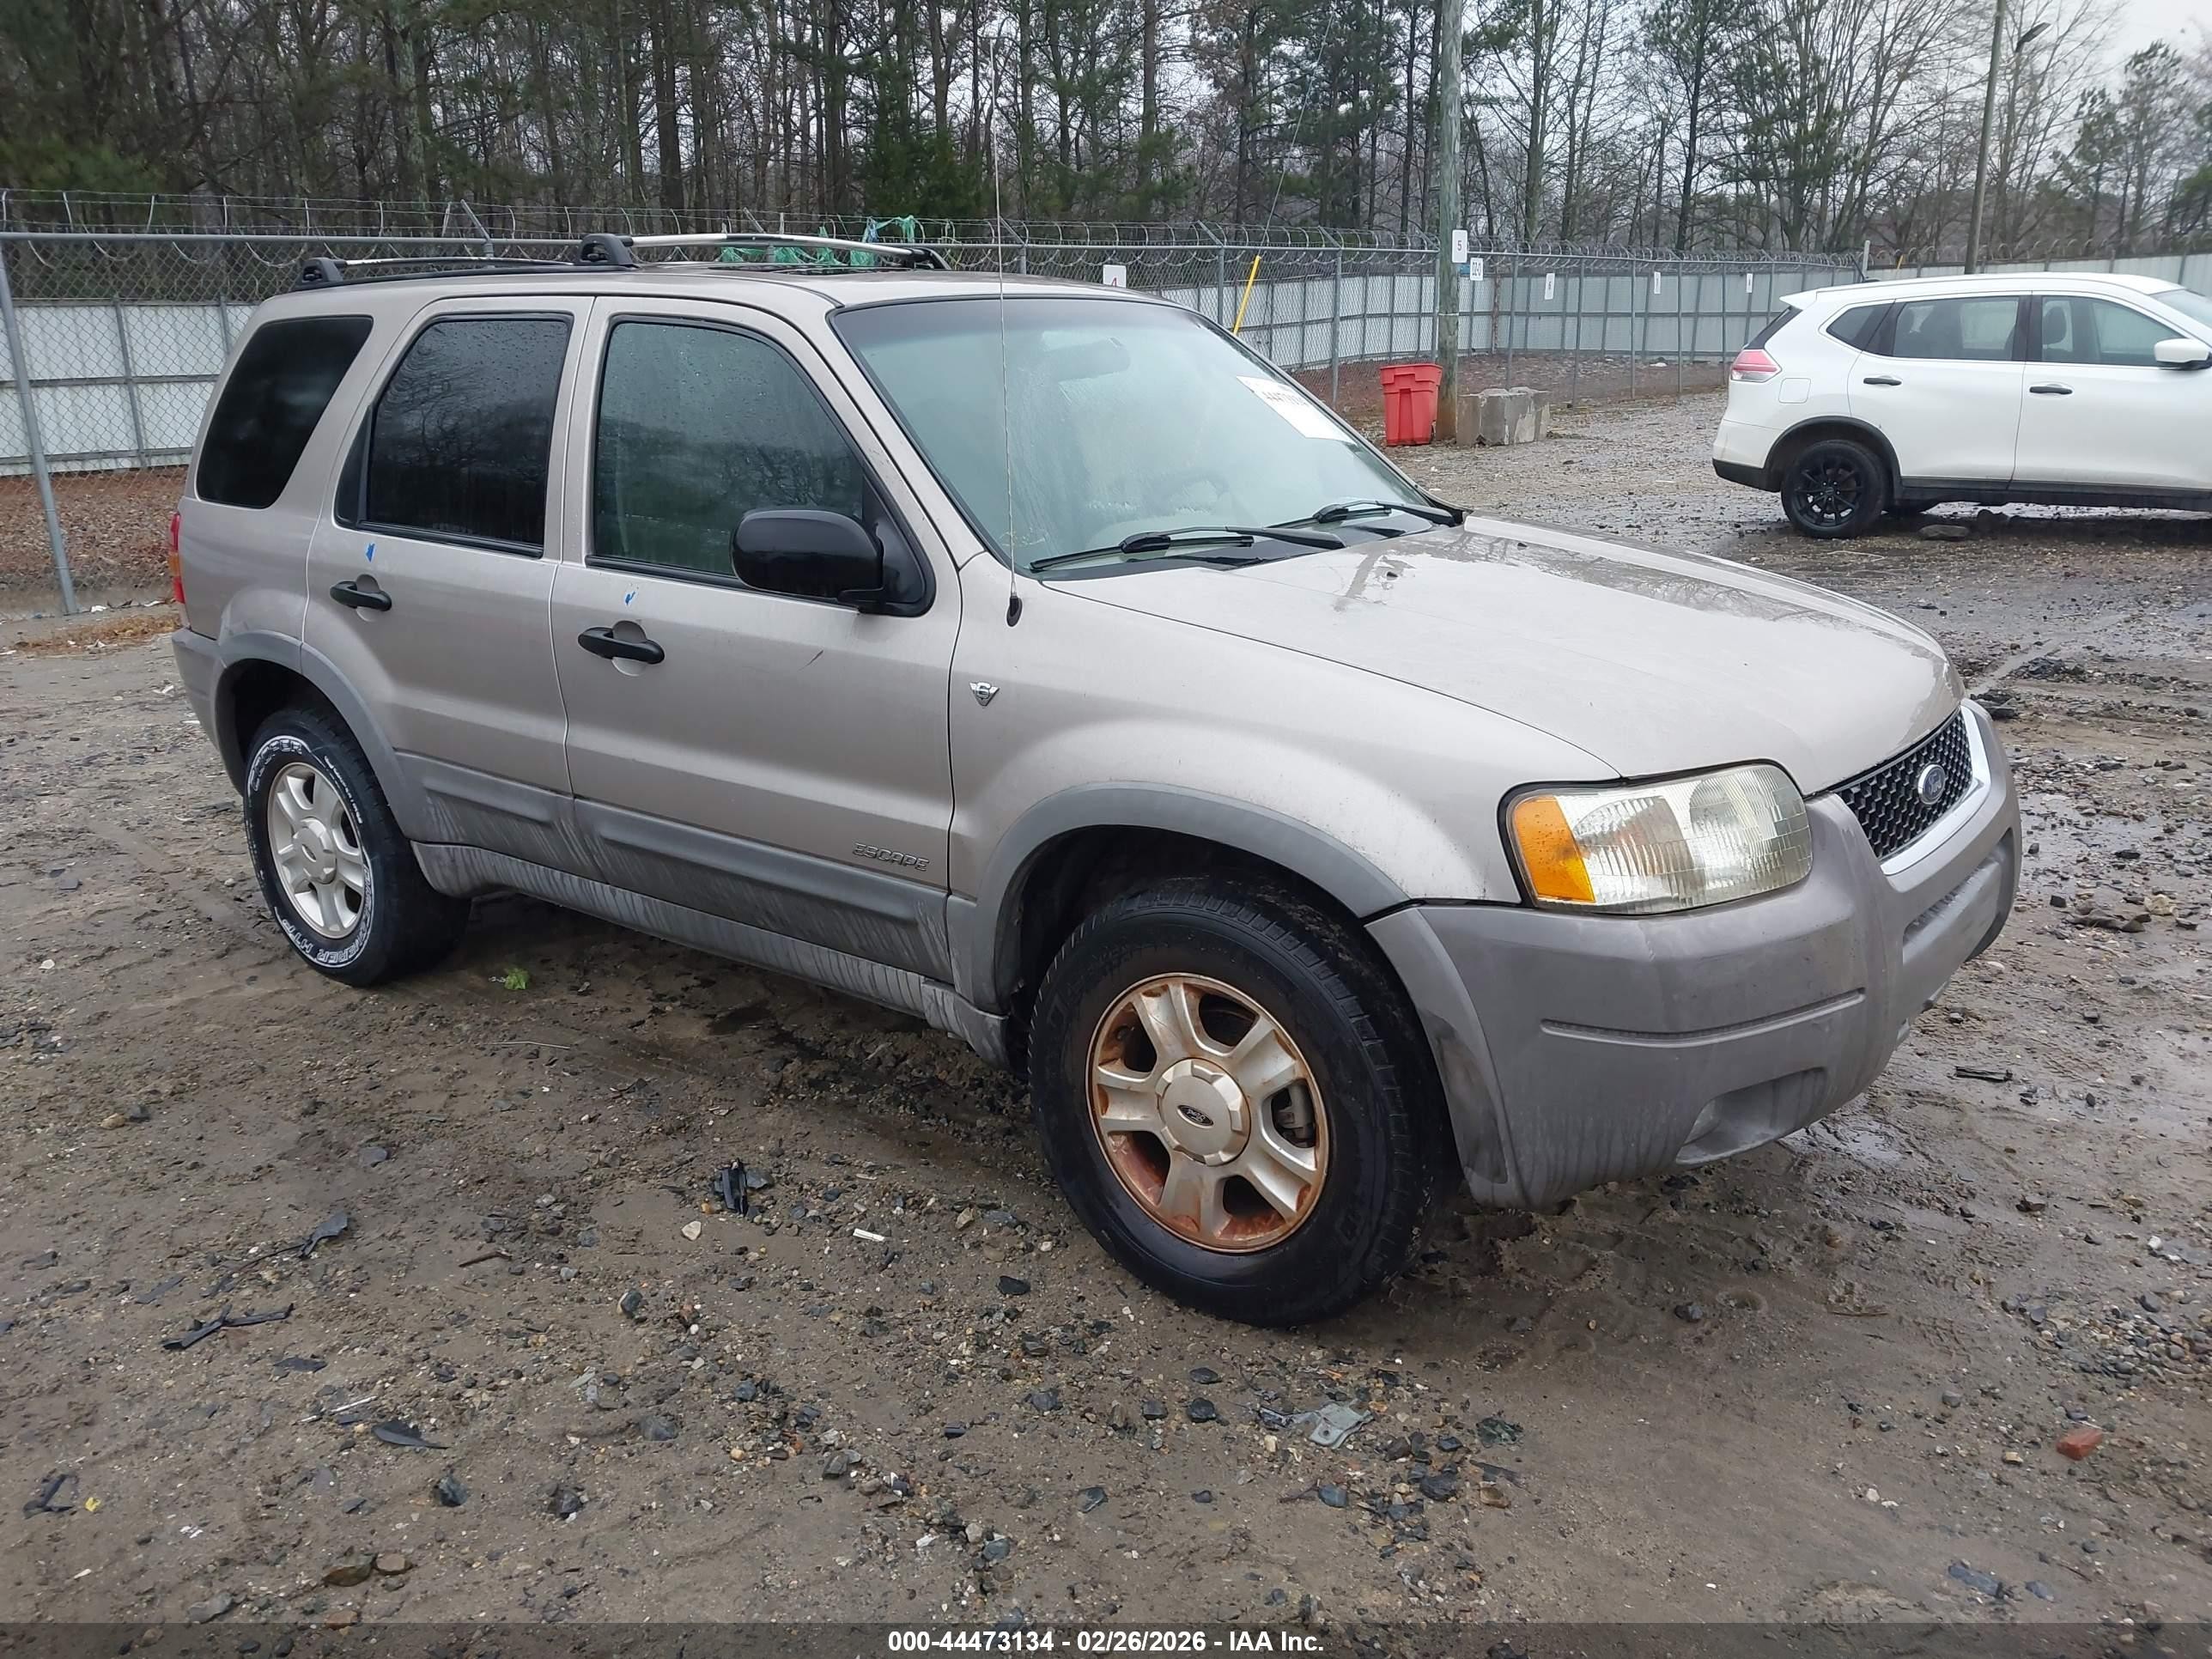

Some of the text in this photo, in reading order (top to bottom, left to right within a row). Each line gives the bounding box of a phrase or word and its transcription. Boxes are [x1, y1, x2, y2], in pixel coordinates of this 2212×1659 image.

[1456, 240, 1462, 252] 5
[852, 842, 930, 872] ESCAPE
[282, 918, 314, 954] HTP
